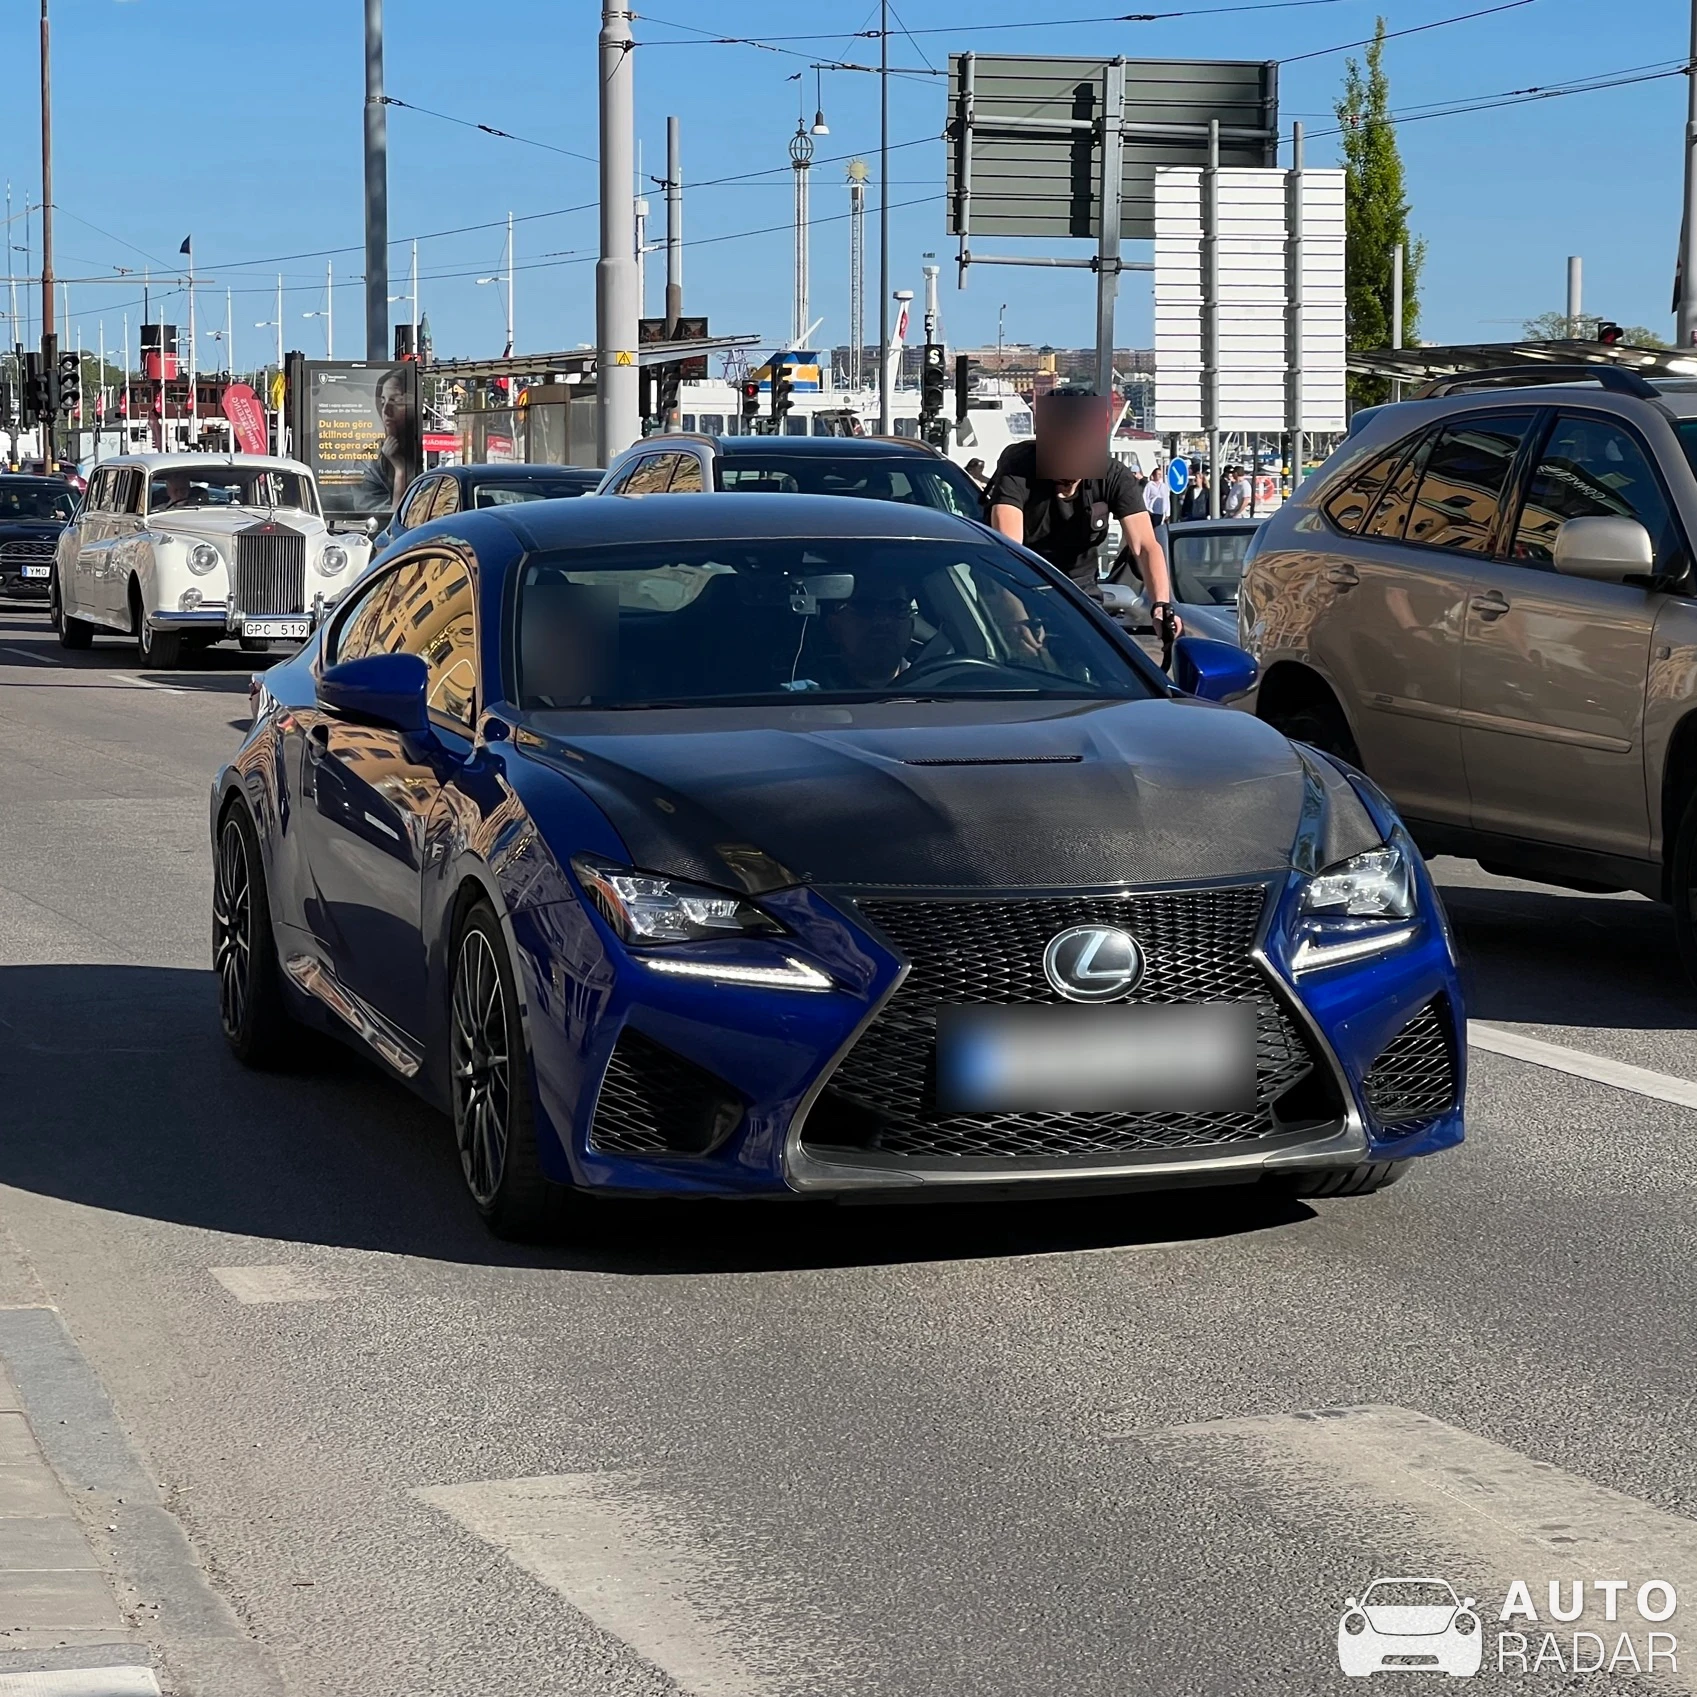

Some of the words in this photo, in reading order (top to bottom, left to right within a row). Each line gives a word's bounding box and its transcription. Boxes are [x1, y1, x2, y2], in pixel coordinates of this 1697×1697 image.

[929, 349, 940, 365] S
[318, 419, 332, 428] Du
[333, 419, 350, 428] kan
[352, 419, 373, 430] göra
[318, 430, 353, 439] skillnad
[354, 431, 386, 440] genom
[318, 441, 333, 450] att
[334, 442, 361, 451] agera
[362, 441, 380, 450] och
[318, 451, 337, 460] visa
[338, 451, 379, 460] omtanke
[246, 623, 271, 635] GPC
[280, 624, 306, 636] 519
